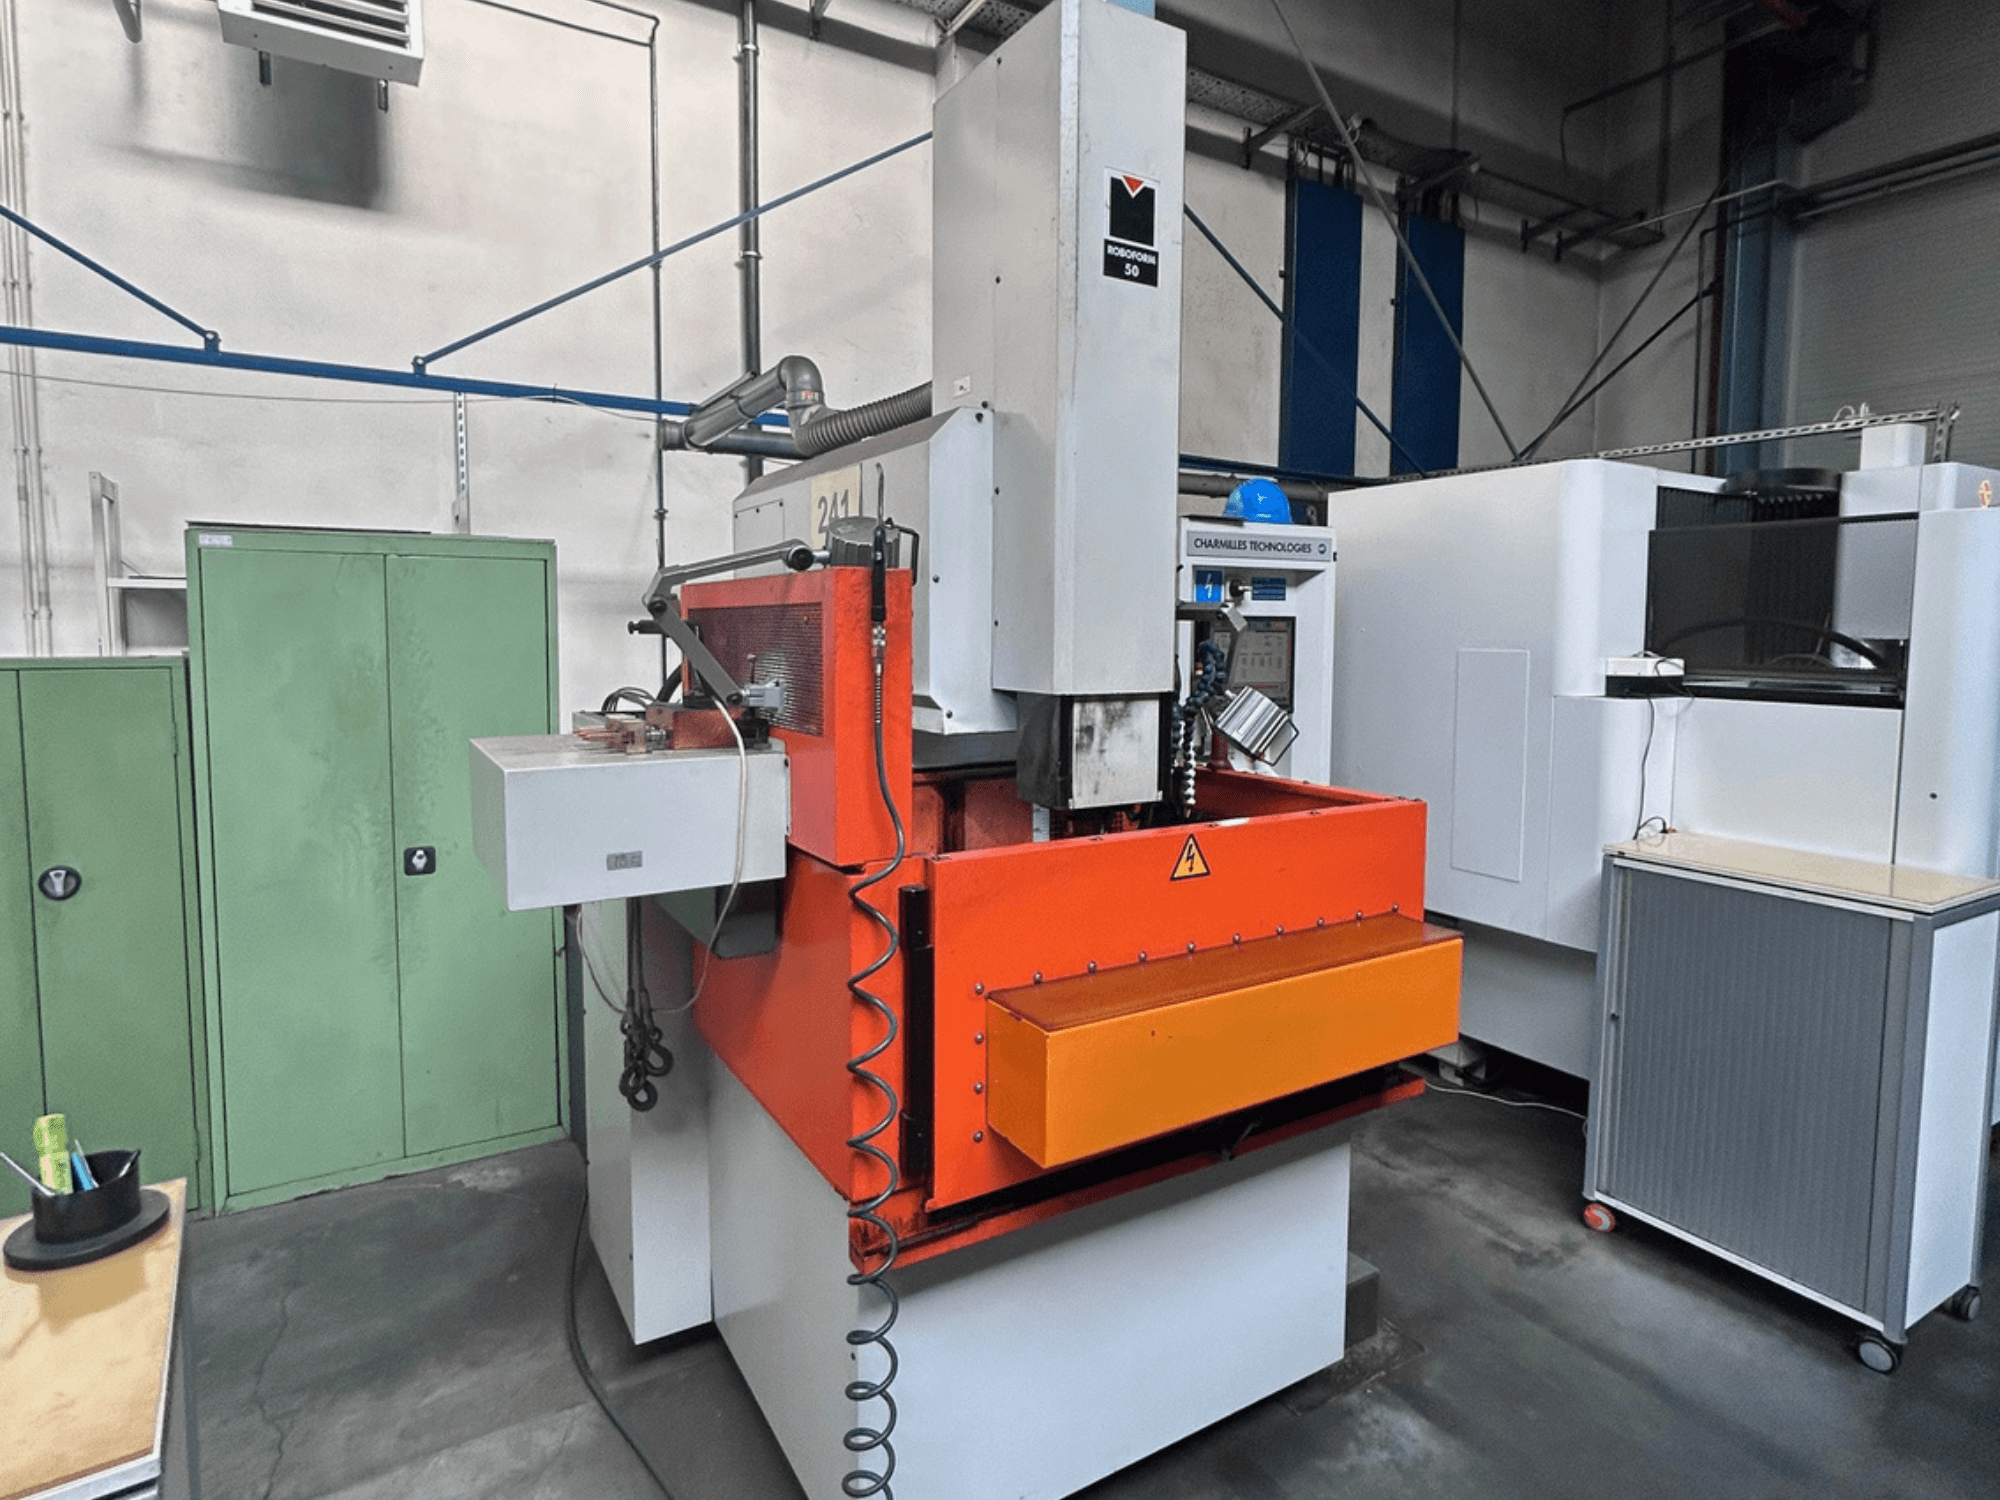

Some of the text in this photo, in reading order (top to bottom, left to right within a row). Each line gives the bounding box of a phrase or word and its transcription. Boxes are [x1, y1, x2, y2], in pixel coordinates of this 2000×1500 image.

[1107, 244, 1156, 265] ROBOFORM
[1124, 263, 1139, 277] 50
[818, 489, 849, 533] 241
[1194, 538, 1312, 553] CHARMILLES TECHNOLOGIES
